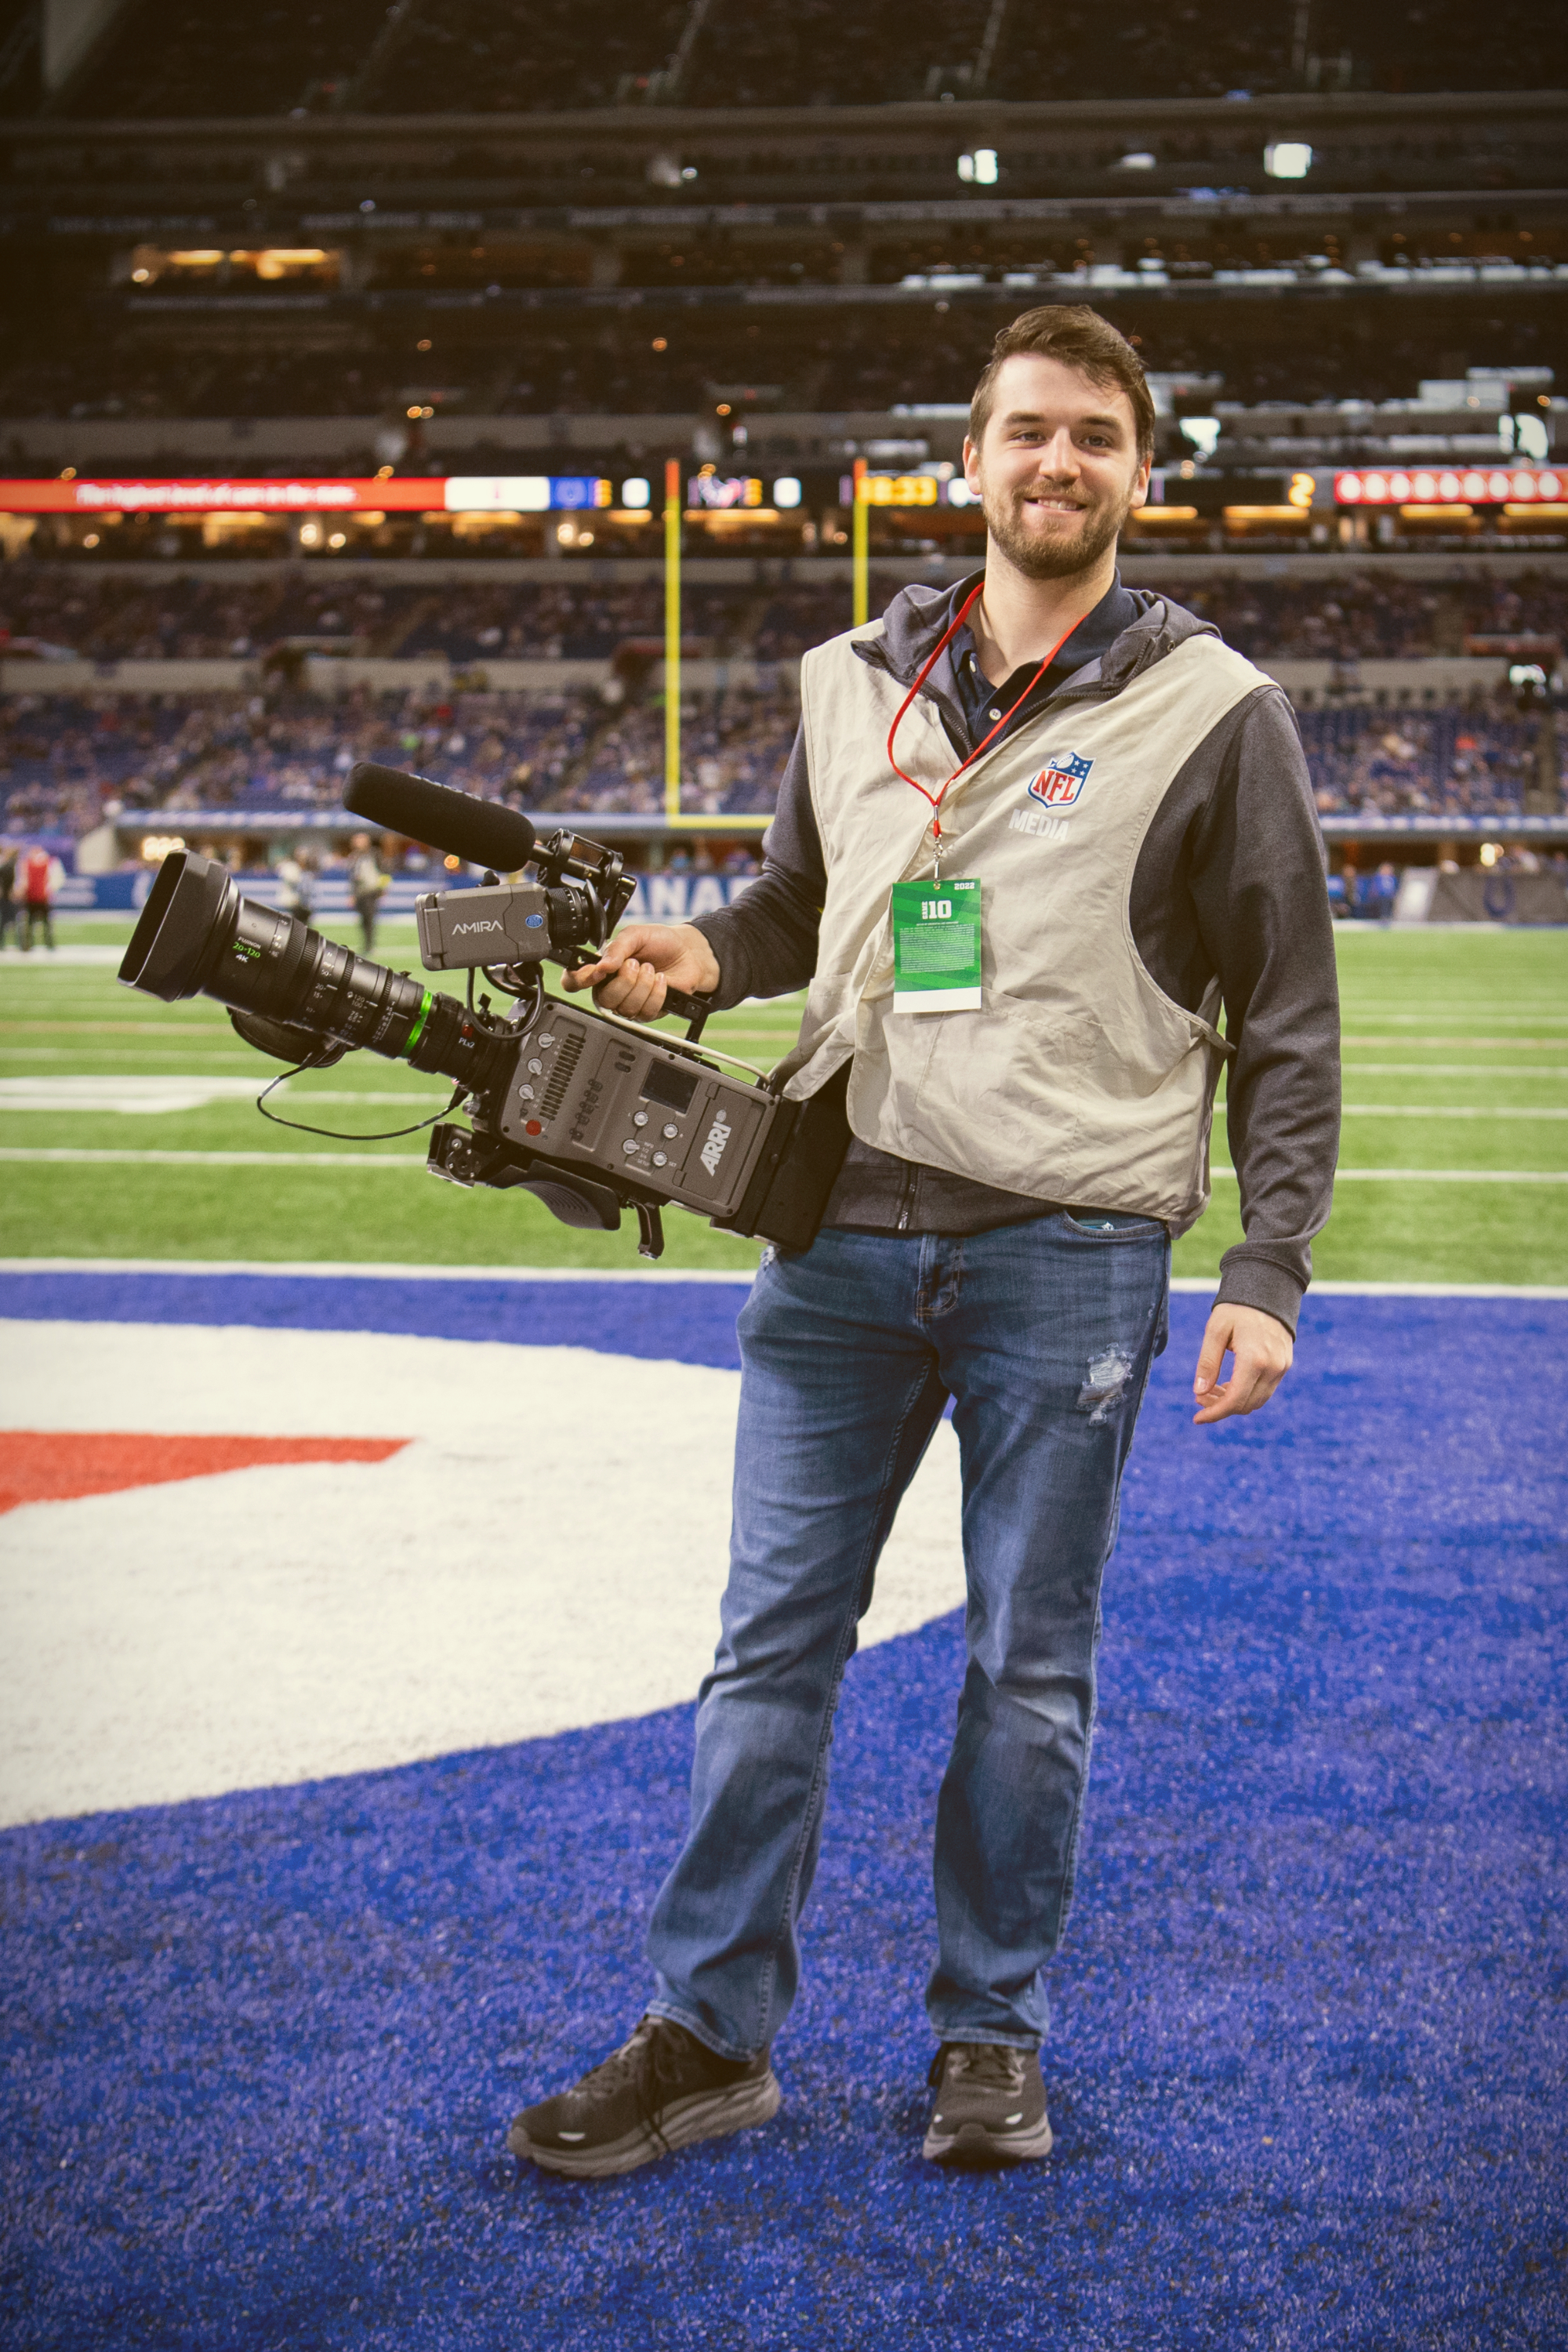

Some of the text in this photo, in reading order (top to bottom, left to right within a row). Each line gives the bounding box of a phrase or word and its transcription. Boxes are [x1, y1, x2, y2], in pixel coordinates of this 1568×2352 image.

[1033, 770, 1076, 802] NFL
[1008, 808, 1069, 841] MEDIA
[954, 882, 975, 891] 2022
[928, 899, 952, 919] 10
[452, 920, 503, 935] AMIRA
[238, 936, 262, 949] FUJINON
[235, 953, 249, 964] 4K
[458, 1036, 475, 1049] PLx2
[700, 1120, 731, 1177] ARRI
